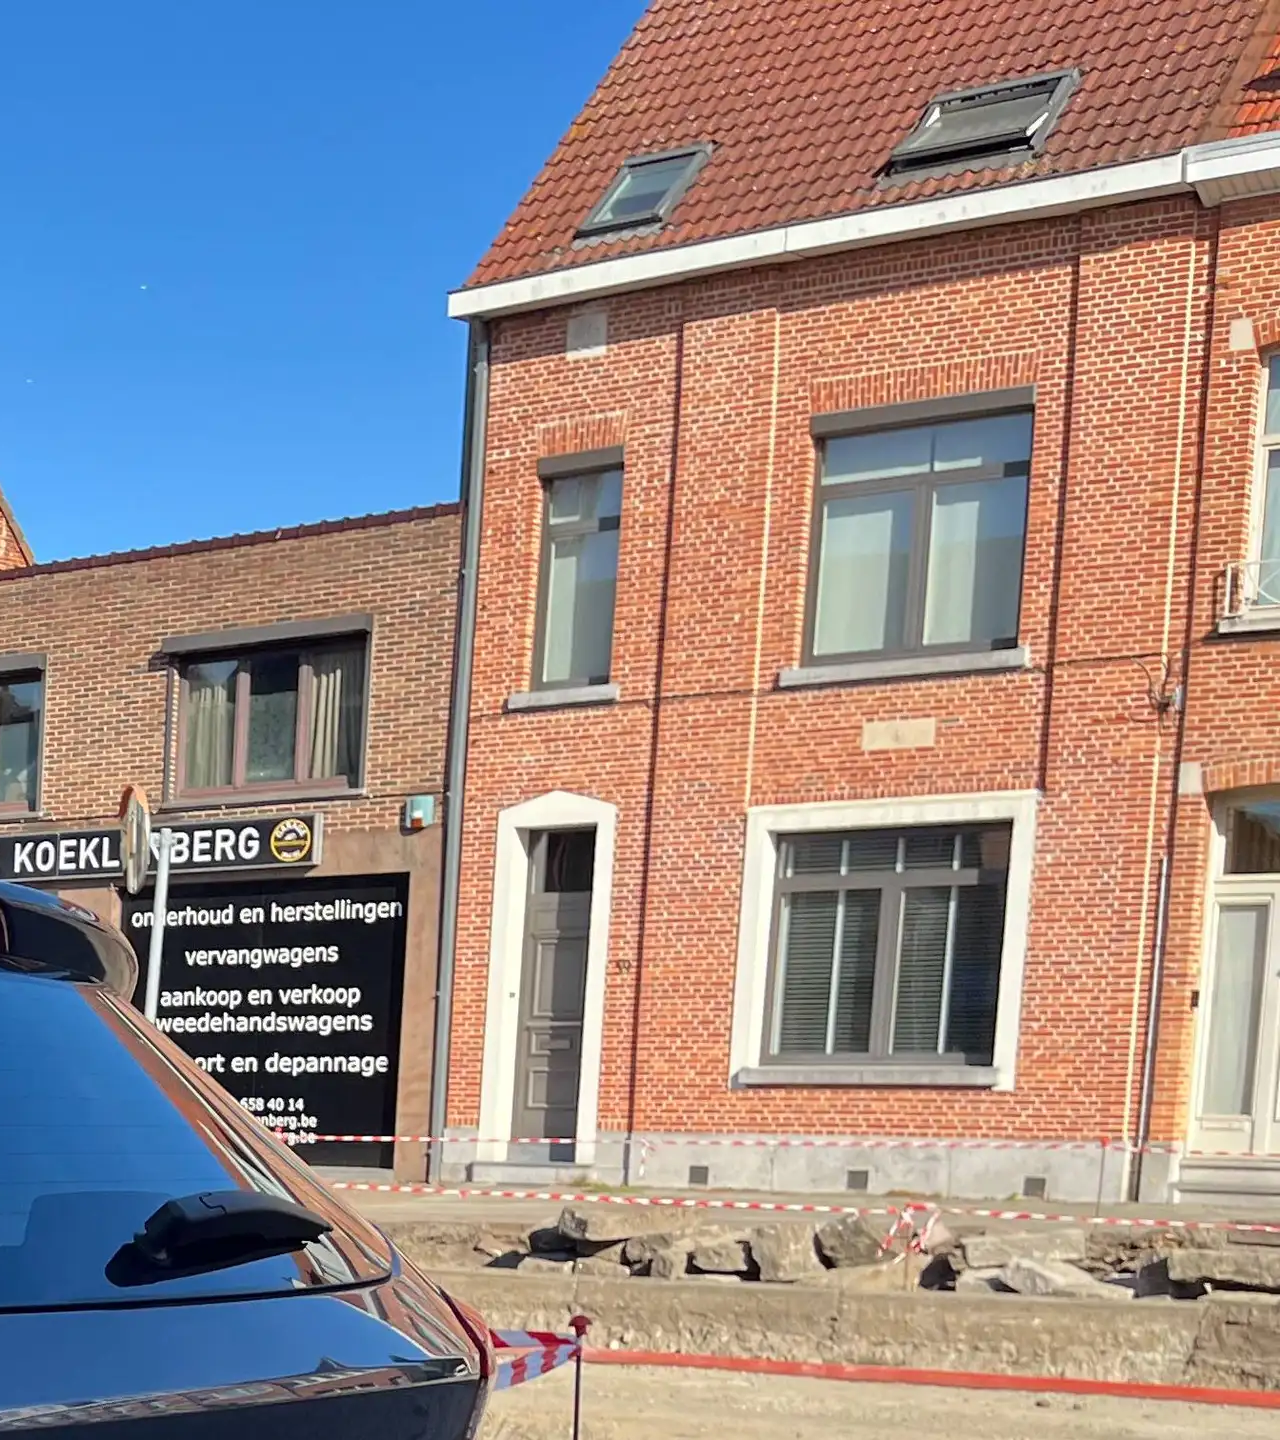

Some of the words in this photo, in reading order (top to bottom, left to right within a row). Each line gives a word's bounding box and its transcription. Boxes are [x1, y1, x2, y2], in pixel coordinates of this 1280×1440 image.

[131, 904, 234, 928] onerhoud
[239, 906, 264, 924] en
[271, 899, 403, 924] herstellingen
[185, 944, 340, 969] vervangwagens
[160, 986, 241, 1010] aankoop
[248, 988, 272, 1006] en
[279, 984, 361, 1008] verkoop
[156, 1011, 373, 1036] weedehandswagens
[231, 1056, 258, 1073] en
[265, 1052, 389, 1077] depannage
[267, 1098, 285, 1112] 40
[288, 1098, 304, 1112] 14
